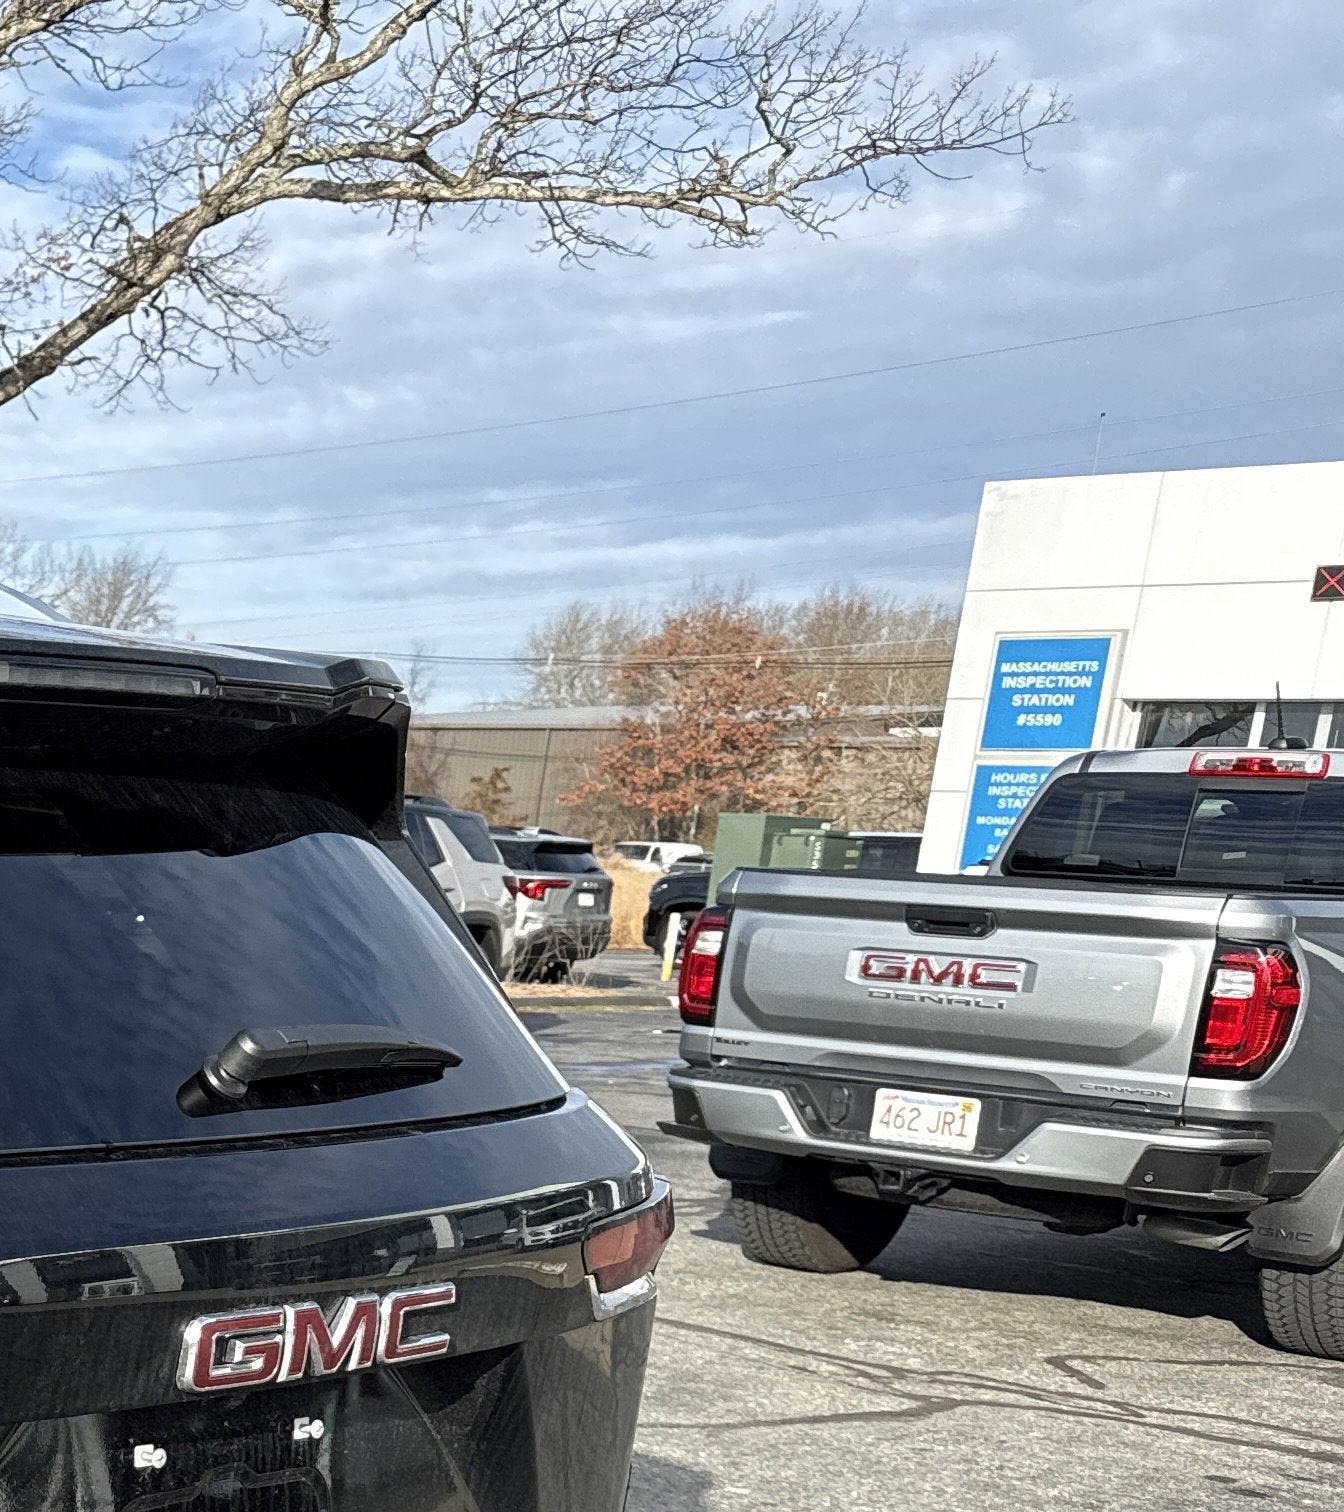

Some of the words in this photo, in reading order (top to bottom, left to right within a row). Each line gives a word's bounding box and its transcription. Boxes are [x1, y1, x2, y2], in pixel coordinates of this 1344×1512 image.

[1000, 661, 1099, 672] MASSACHUSETTS
[1002, 676, 1092, 688] INSPECTION
[1012, 694, 1075, 706] STATION
[1016, 714, 1062, 726] #5590
[991, 773, 1037, 784] HOURS
[988, 785, 1038, 796] INSPEC
[997, 798, 1031, 808] STAT
[976, 816, 1017, 825] MONDA
[861, 951, 1026, 993] GMC
[867, 987, 1007, 1010] DENALI
[1079, 1082, 1173, 1098] CANYON
[879, 1105, 922, 1131] 462
[927, 1110, 968, 1137] JR1
[1257, 1226, 1314, 1243] GMC
[176, 1281, 457, 1394] GMC
